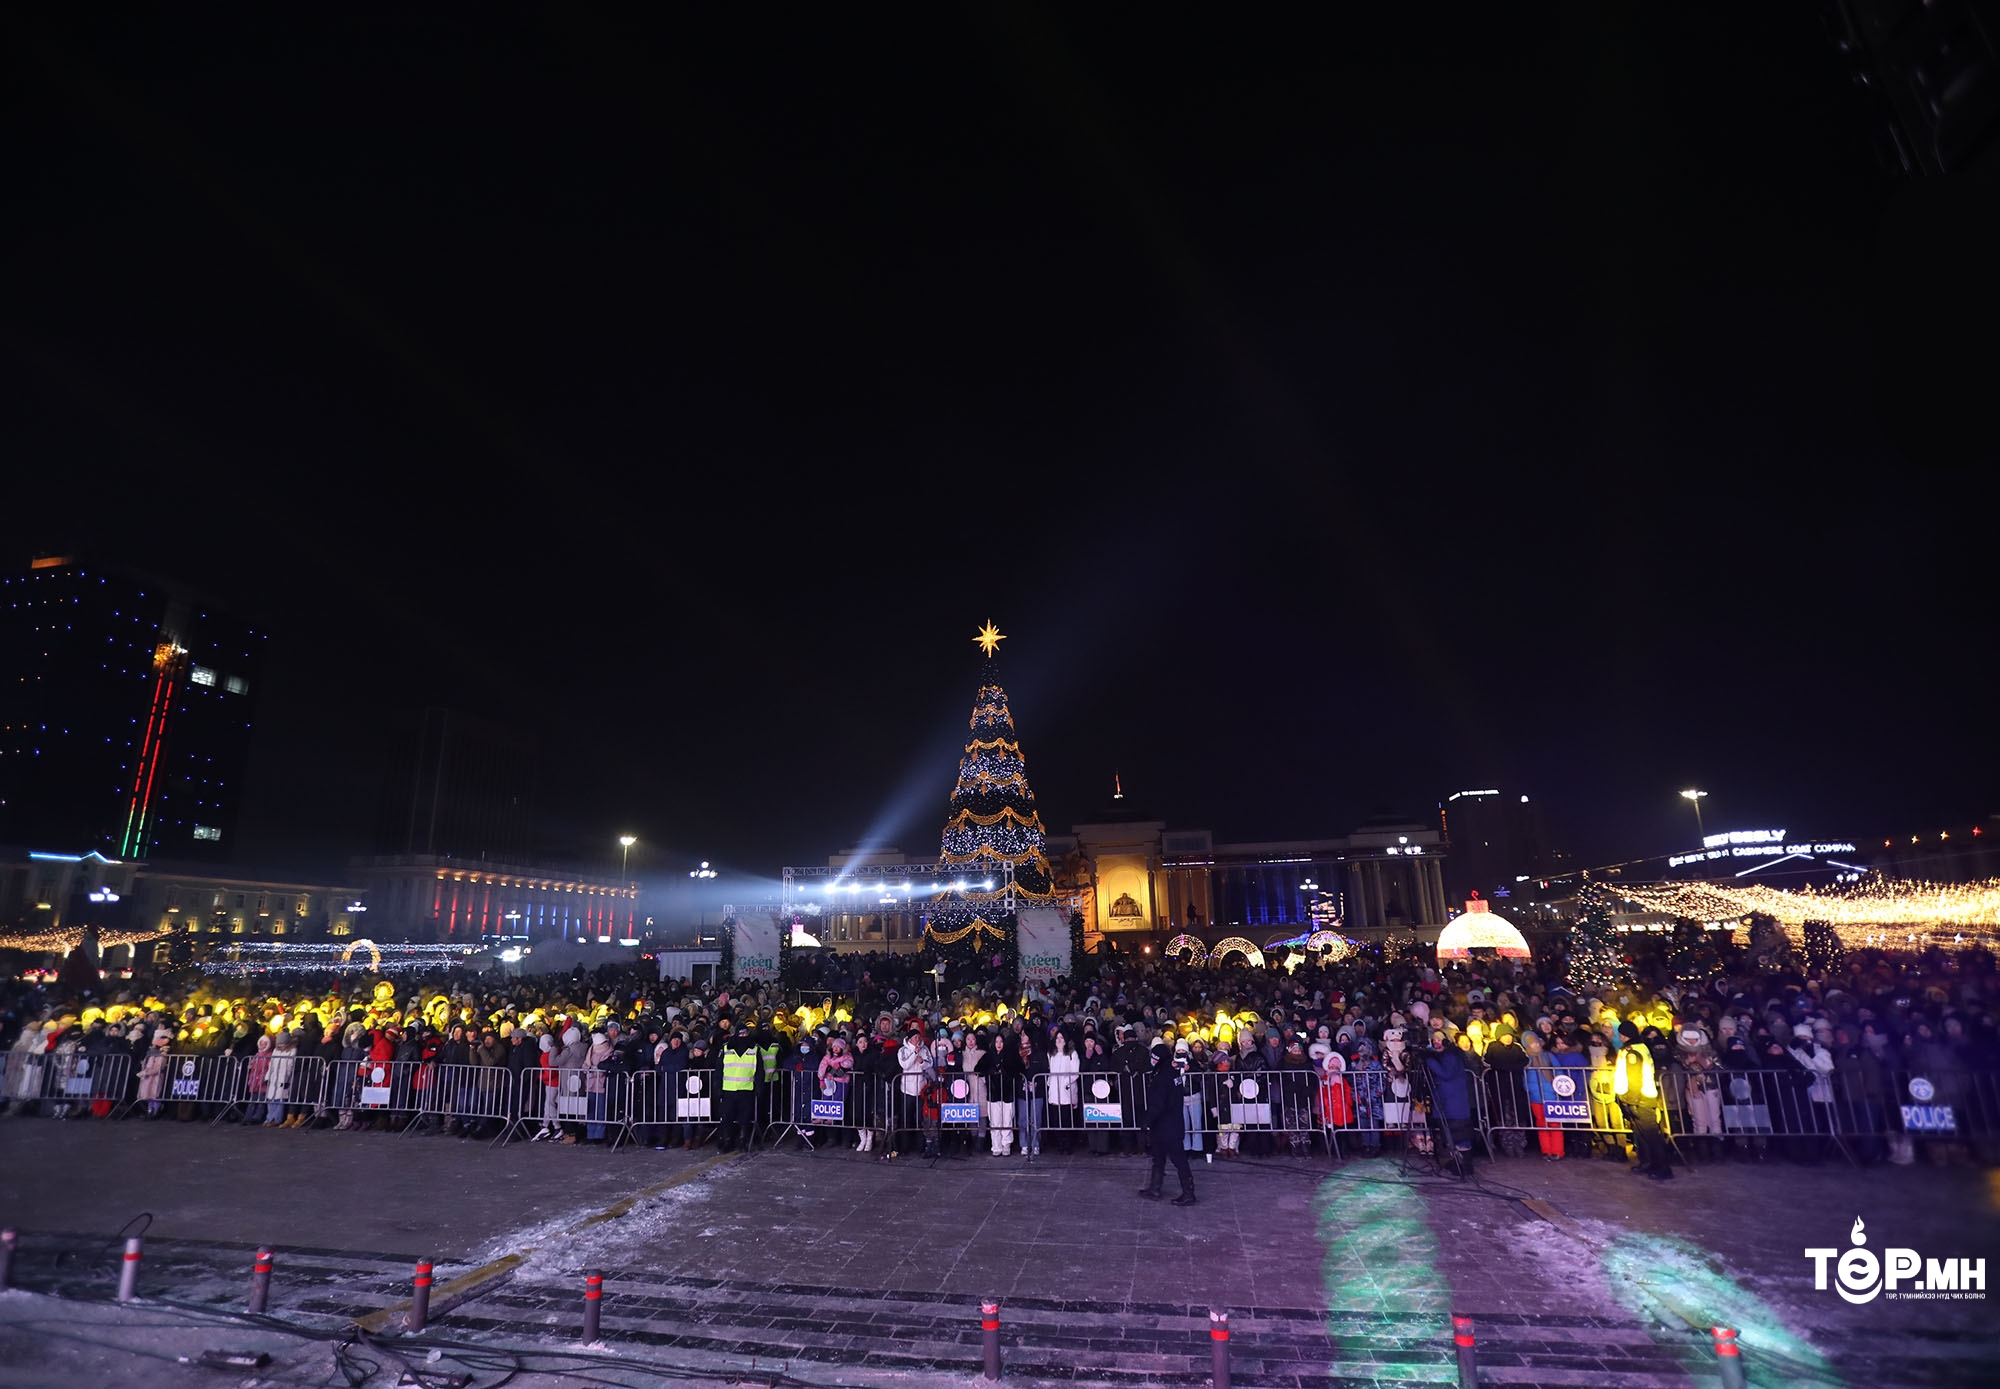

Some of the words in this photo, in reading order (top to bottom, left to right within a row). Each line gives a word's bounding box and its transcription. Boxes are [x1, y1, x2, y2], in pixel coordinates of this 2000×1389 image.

[1785, 844, 1812, 854] COAT
[1021, 954, 1068, 970] Green
[172, 1080, 199, 1096] POLICE
[814, 1104, 841, 1115] POLICE
[944, 1108, 977, 1118] POLICE
[1547, 1105, 1588, 1116] POLICE
[1901, 1106, 1956, 1128] POLICE
